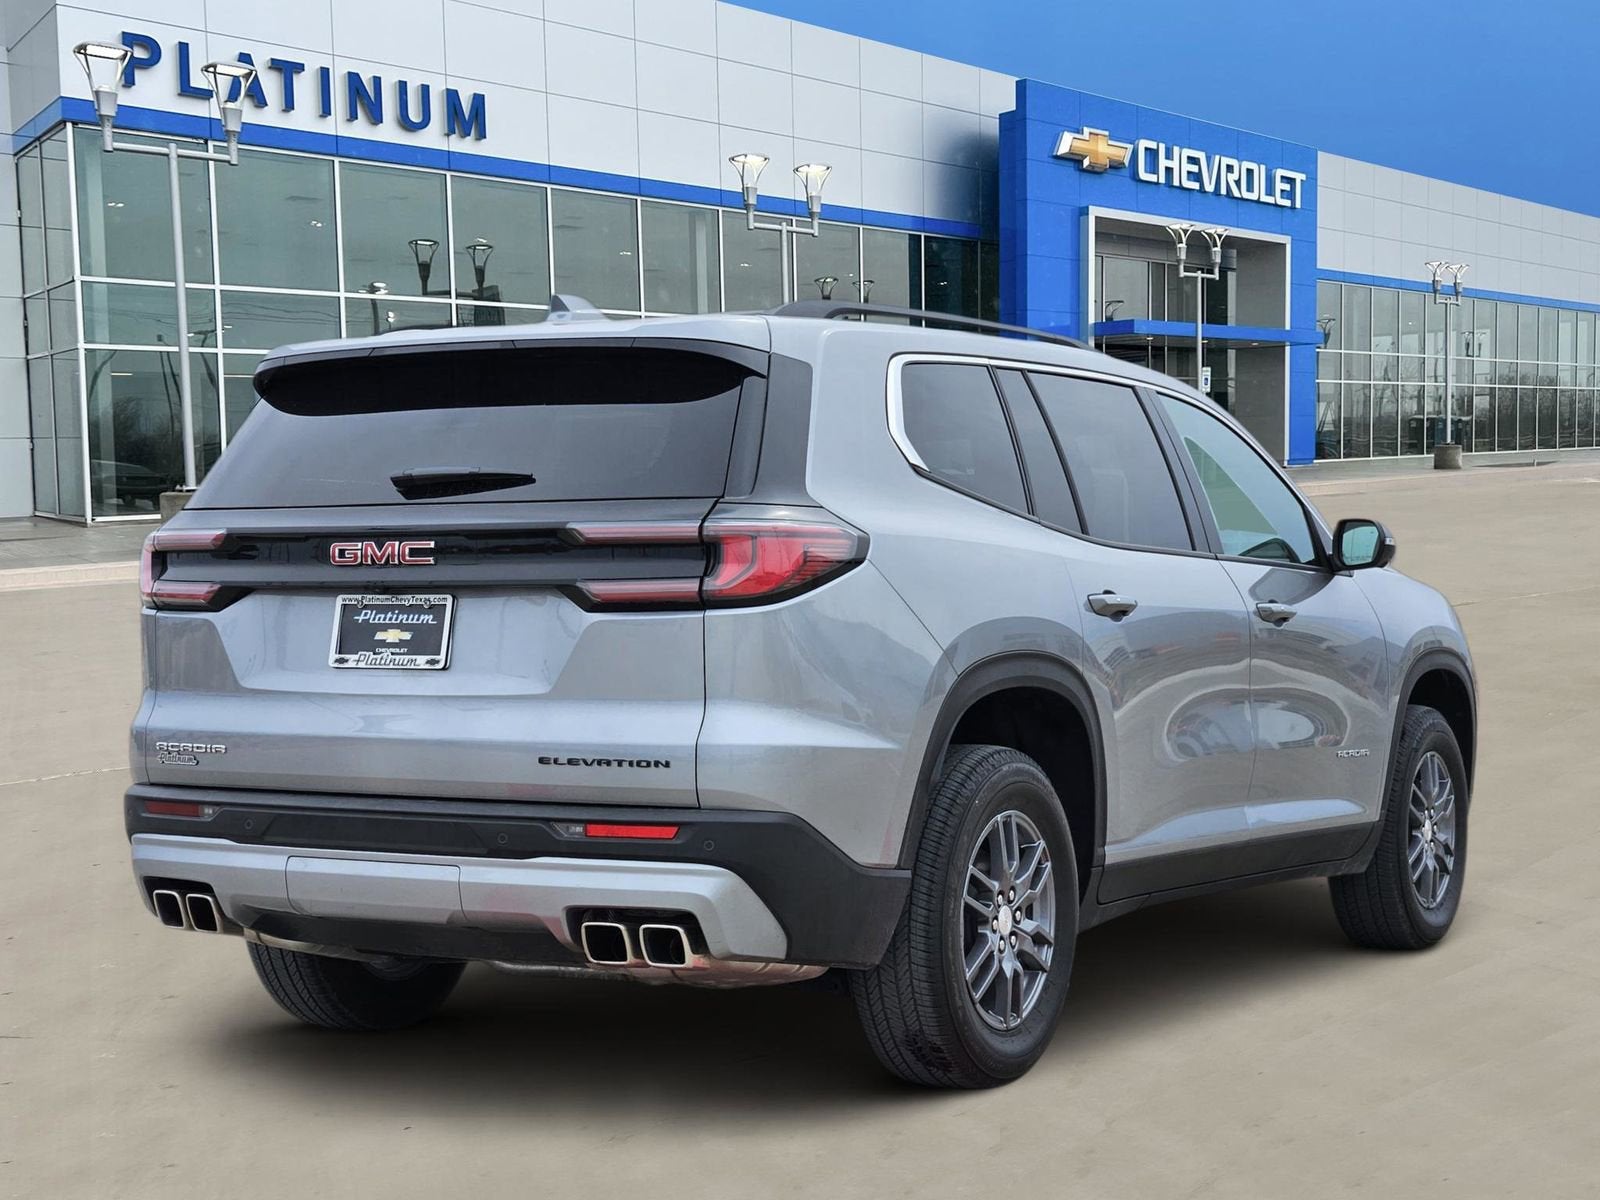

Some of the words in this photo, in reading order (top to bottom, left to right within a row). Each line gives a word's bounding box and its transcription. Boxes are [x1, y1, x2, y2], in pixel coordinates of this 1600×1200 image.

[121, 30, 487, 141] PLATINUM
[1136, 138, 1307, 209] CHEVROLET
[330, 540, 436, 566] GMC
[341, 595, 448, 605] www.PlatinumChevyTexas.com
[353, 609, 438, 624] Platinum
[352, 652, 421, 668] Platinum
[156, 741, 227, 754] ACADIA
[1337, 748, 1370, 758] ACADIA
[537, 756, 671, 768] ELEVATION
